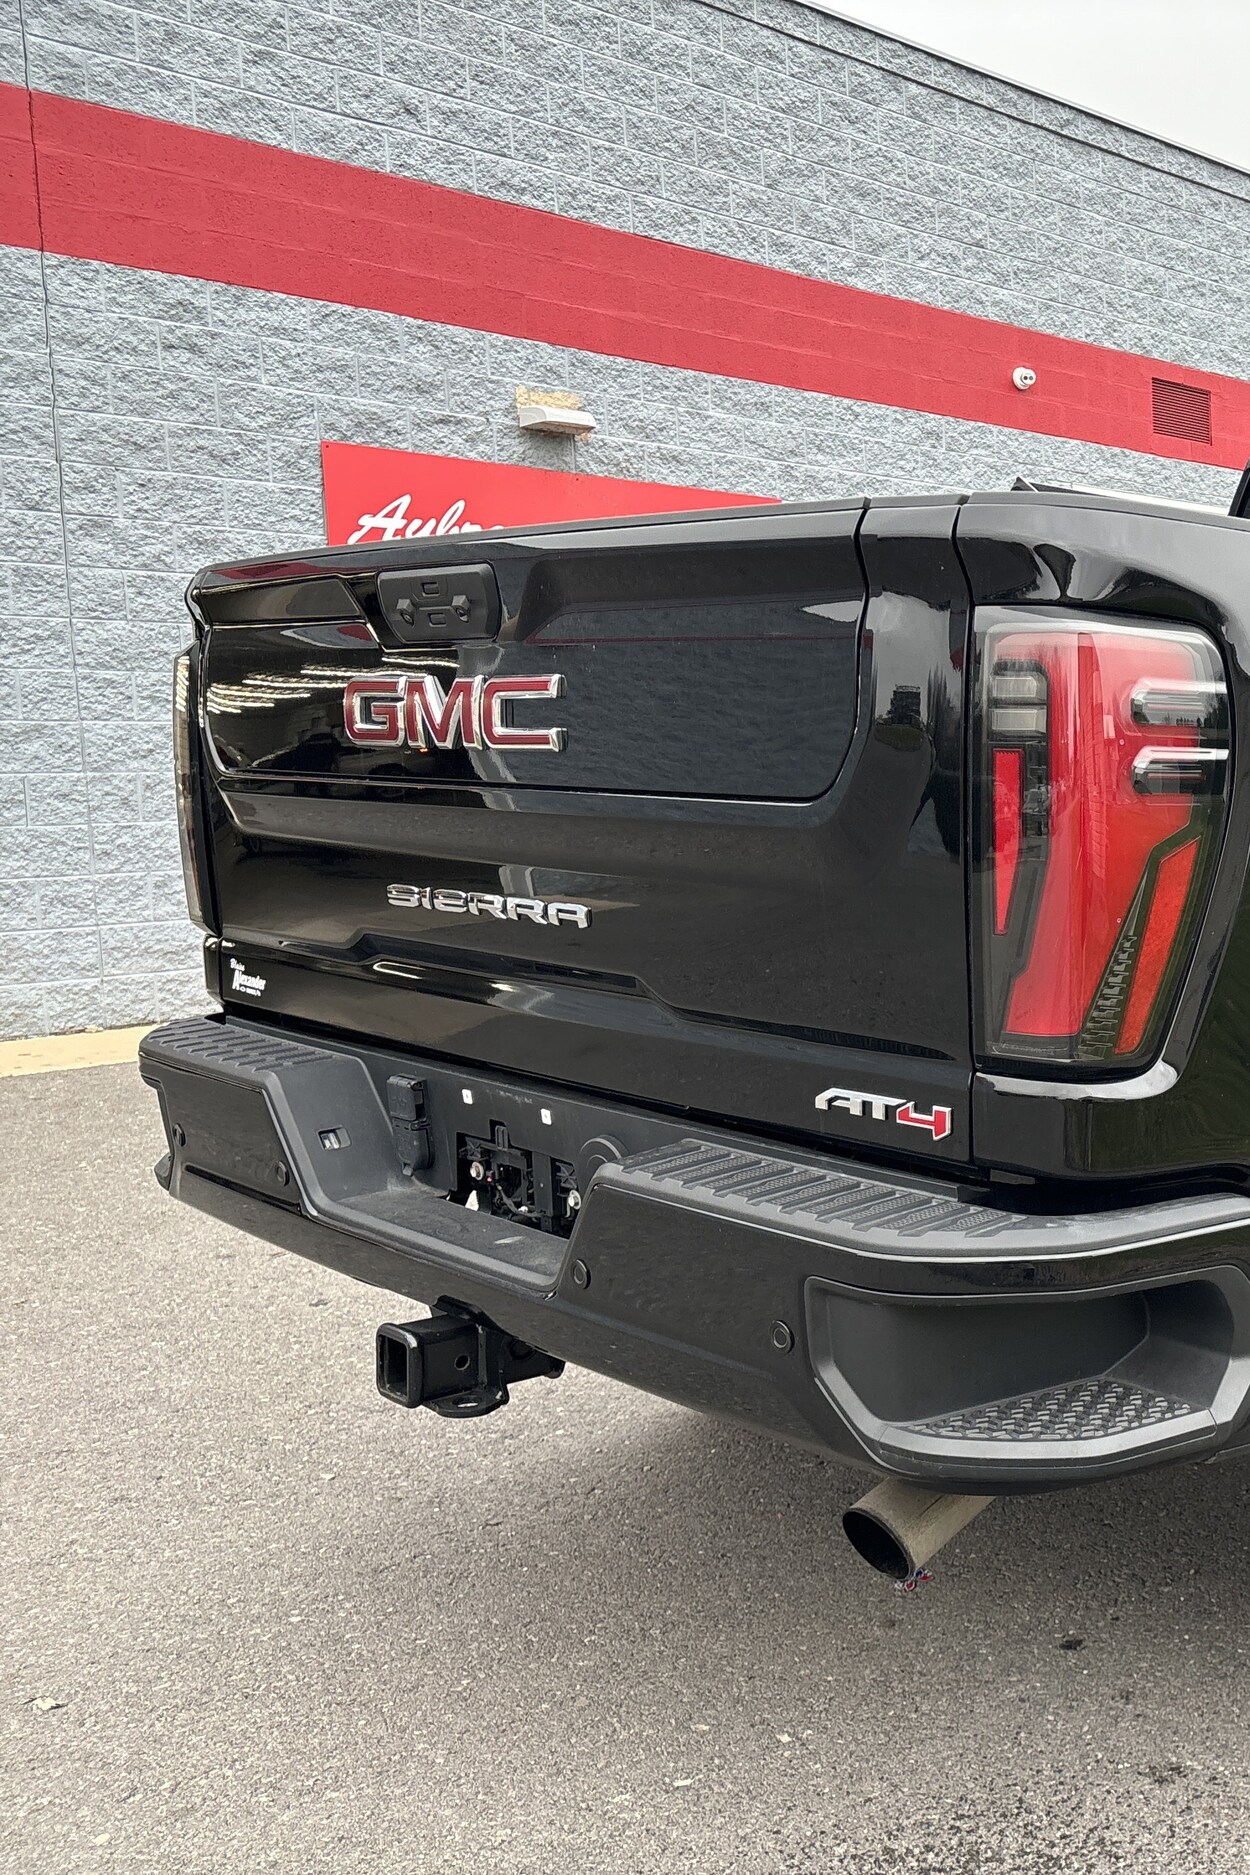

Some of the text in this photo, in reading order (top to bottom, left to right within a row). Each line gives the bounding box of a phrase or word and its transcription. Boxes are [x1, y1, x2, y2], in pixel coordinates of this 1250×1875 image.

[343, 674, 568, 751] GMC
[386, 884, 593, 929] SIERRA
[814, 1087, 952, 1141] AT4
